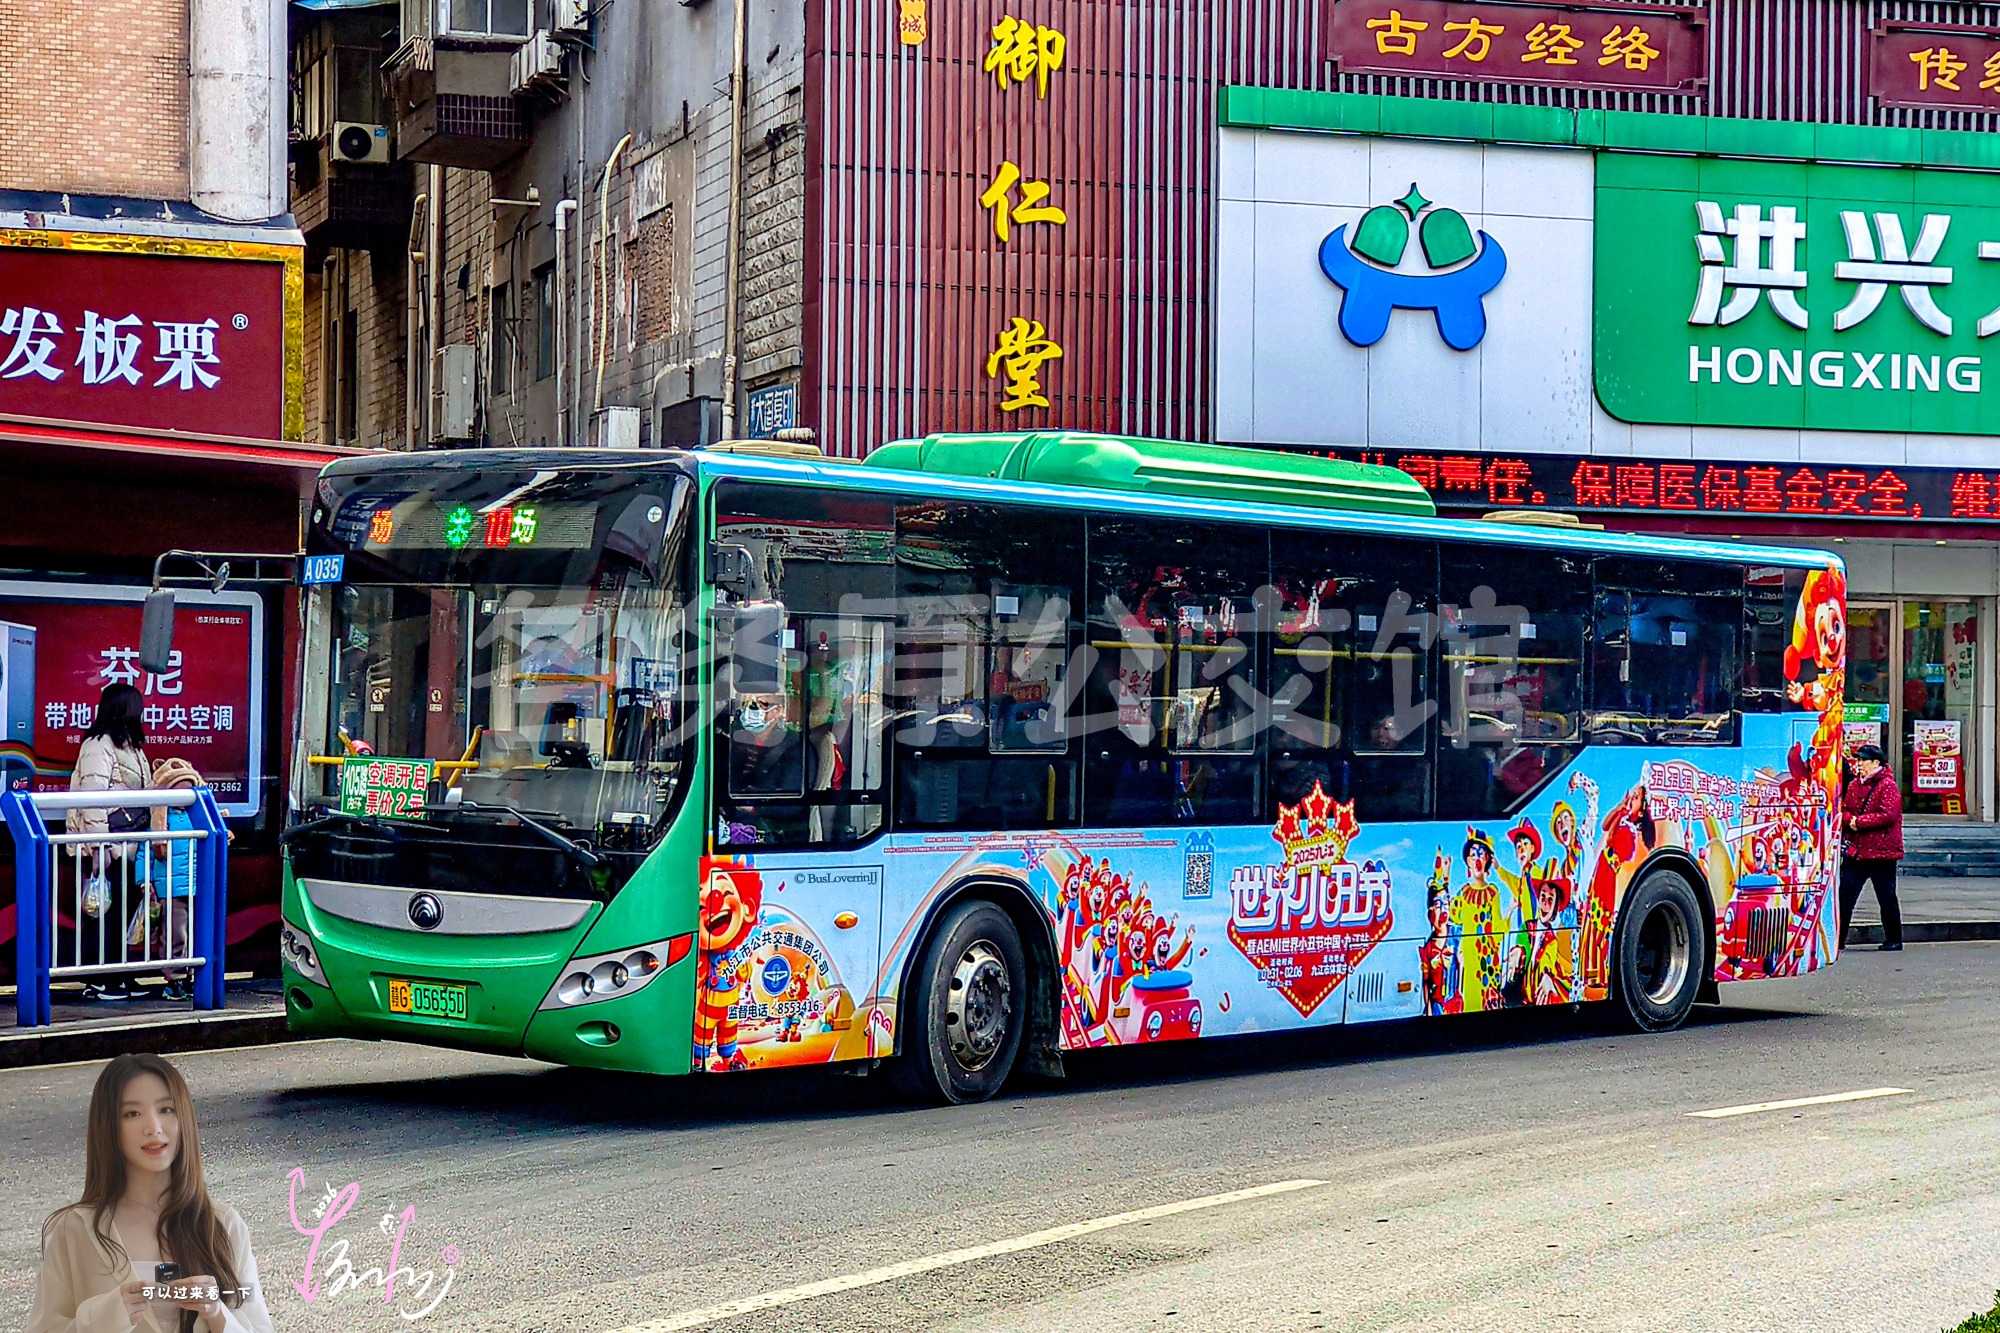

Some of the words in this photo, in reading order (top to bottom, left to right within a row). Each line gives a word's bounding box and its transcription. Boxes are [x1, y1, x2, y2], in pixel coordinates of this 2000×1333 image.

[1366, 10, 1660, 71] 古方经络
[981, 14, 1067, 411] 御仁堂
[1688, 200, 2000, 338] 洪兴
[0, 306, 221, 390] 发板栗
[1688, 345, 1982, 394] HONGXING
[100, 647, 183, 695] 芬尼
[44, 702, 233, 731] 带地中央空调
[220, 782, 242, 792] 5862
[367, 762, 428, 791] 空调开启
[365, 790, 425, 819] 票价2元
[1292, 843, 1335, 865] 2025九江
[1231, 864, 1391, 928] 世界小丑节
[721, 930, 830, 981] 九江市公共交通集团公司
